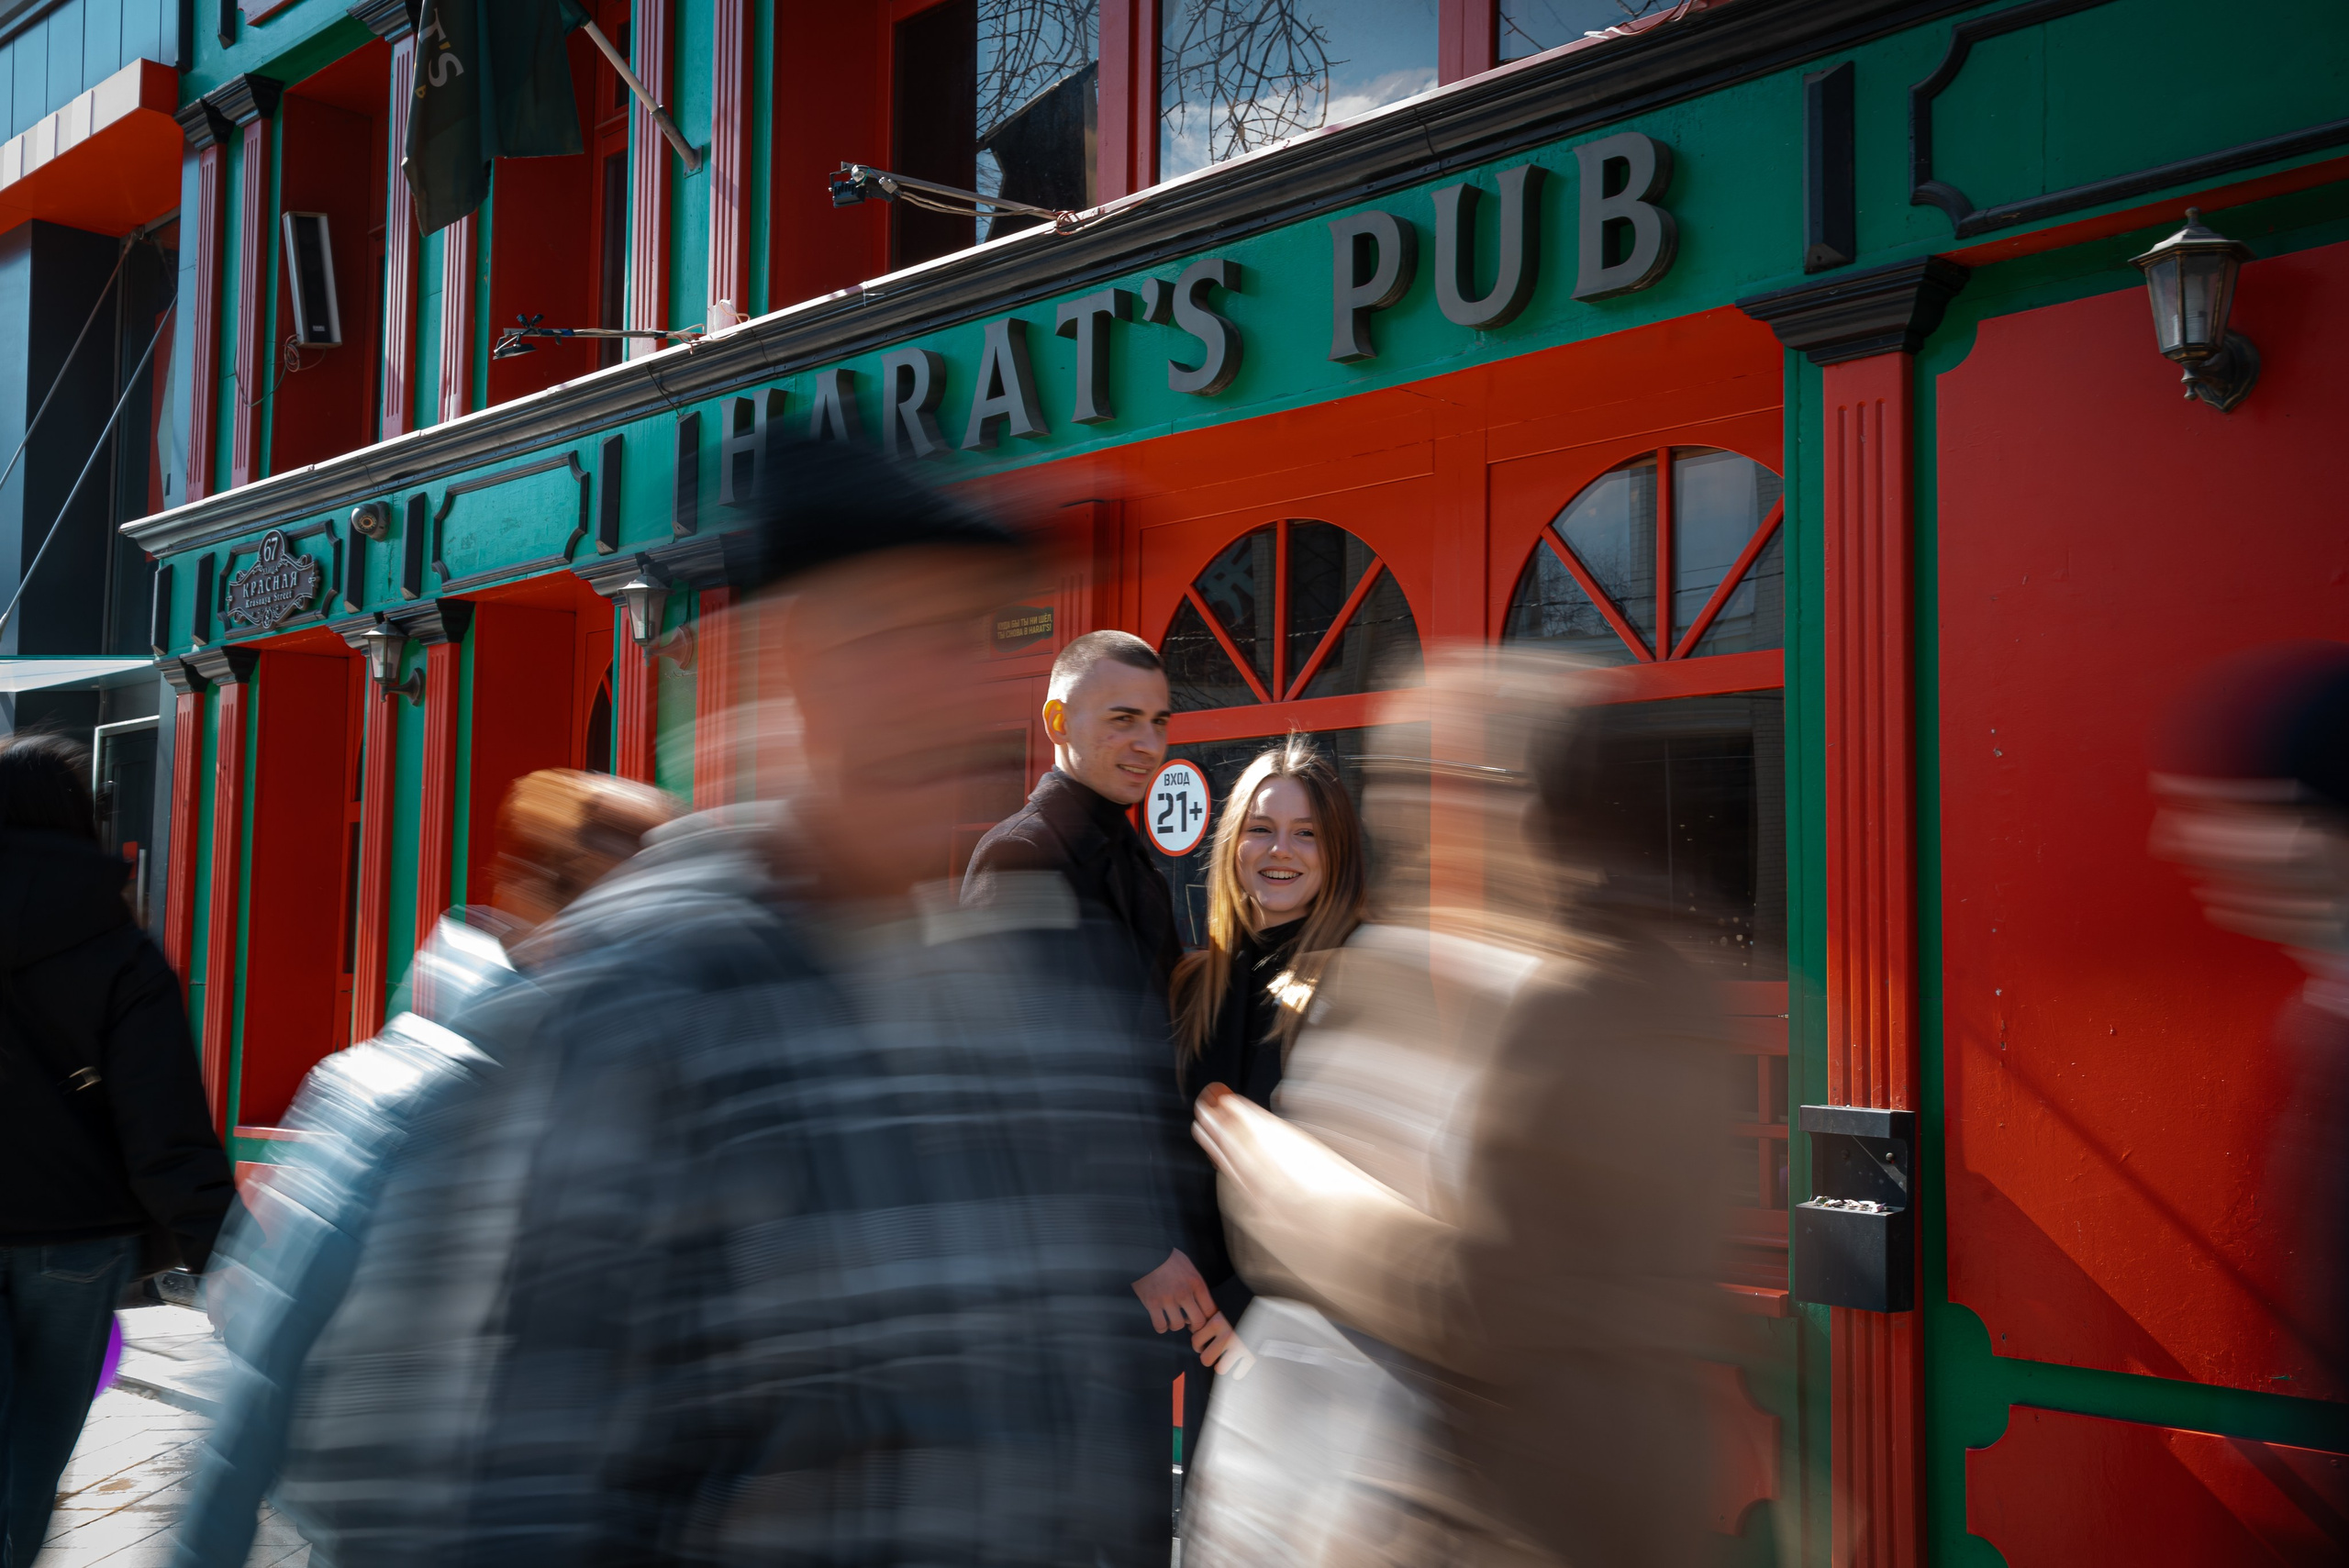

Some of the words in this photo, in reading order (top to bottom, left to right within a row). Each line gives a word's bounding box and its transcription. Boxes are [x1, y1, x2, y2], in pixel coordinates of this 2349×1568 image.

[1327, 130, 1680, 362] PUB
[263, 537, 278, 562] 67
[242, 571, 297, 597] КРАСНАЯ
[246, 596, 271, 607] Krasnaya
[273, 591, 292, 601] Street
[1164, 772, 1190, 785] ВХОД
[1157, 792, 1202, 833] 21+
